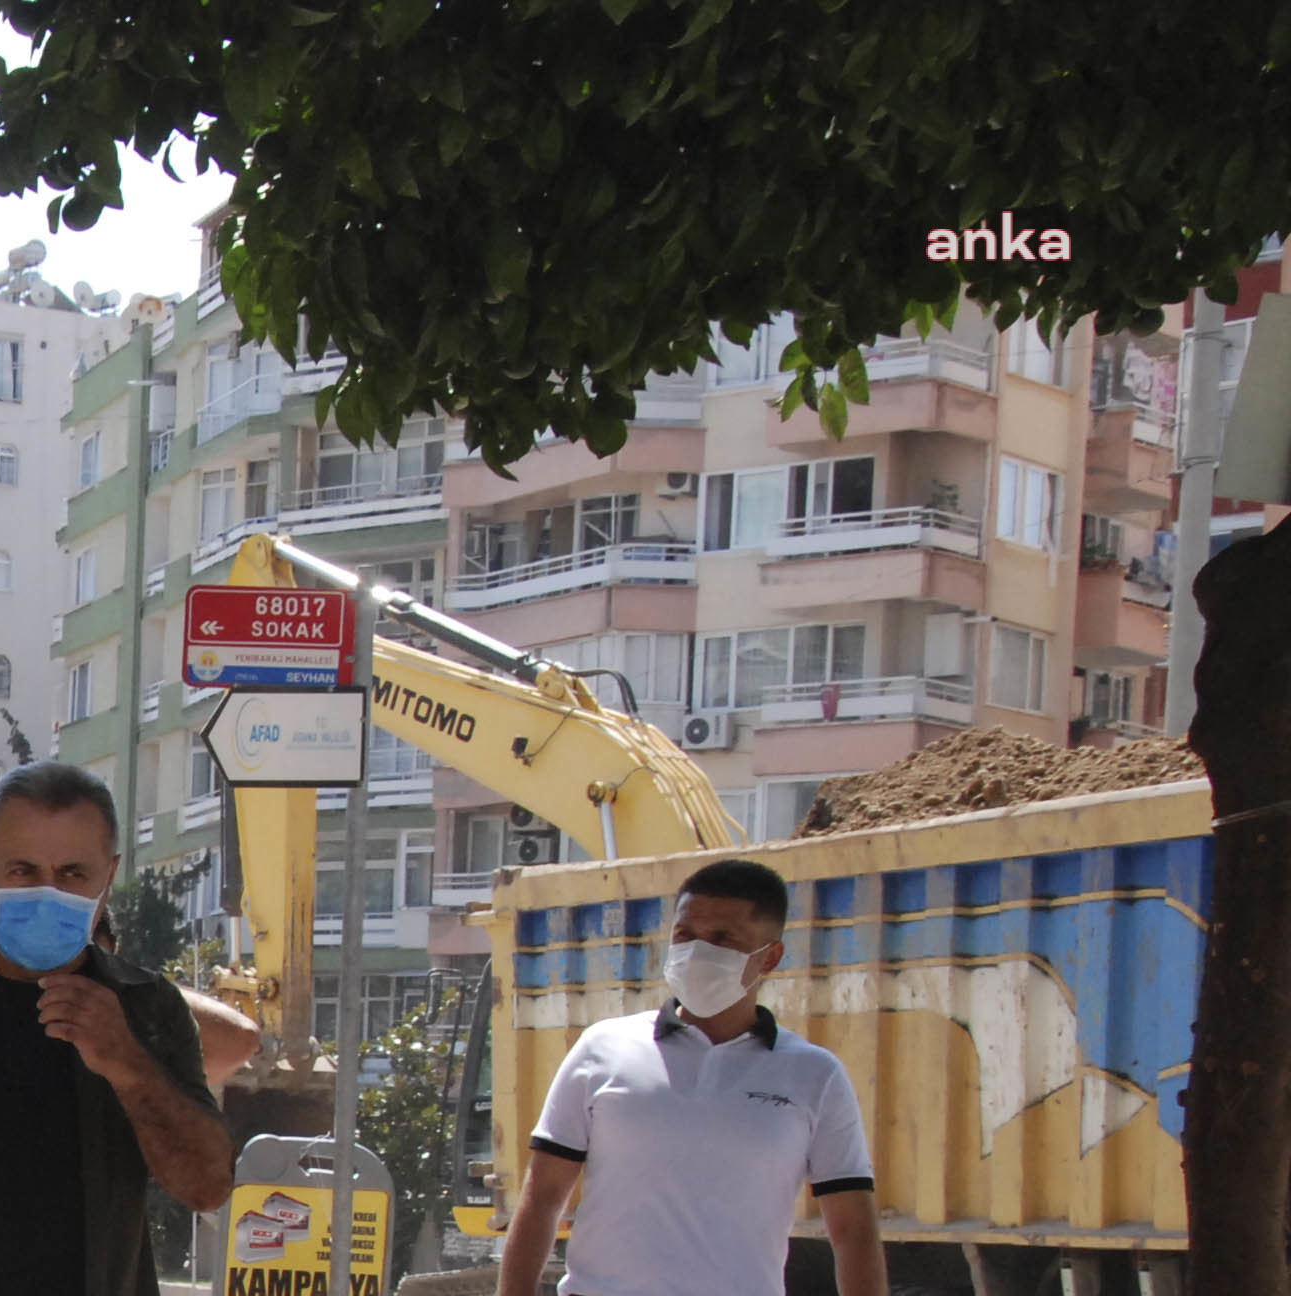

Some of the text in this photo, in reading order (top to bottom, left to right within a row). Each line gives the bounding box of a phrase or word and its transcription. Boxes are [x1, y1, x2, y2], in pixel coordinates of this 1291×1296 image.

[255, 596, 326, 617] 68017
[251, 620, 324, 639] SOKAK
[286, 671, 336, 684] SEYHAN
[250, 725, 280, 742] AFAD
